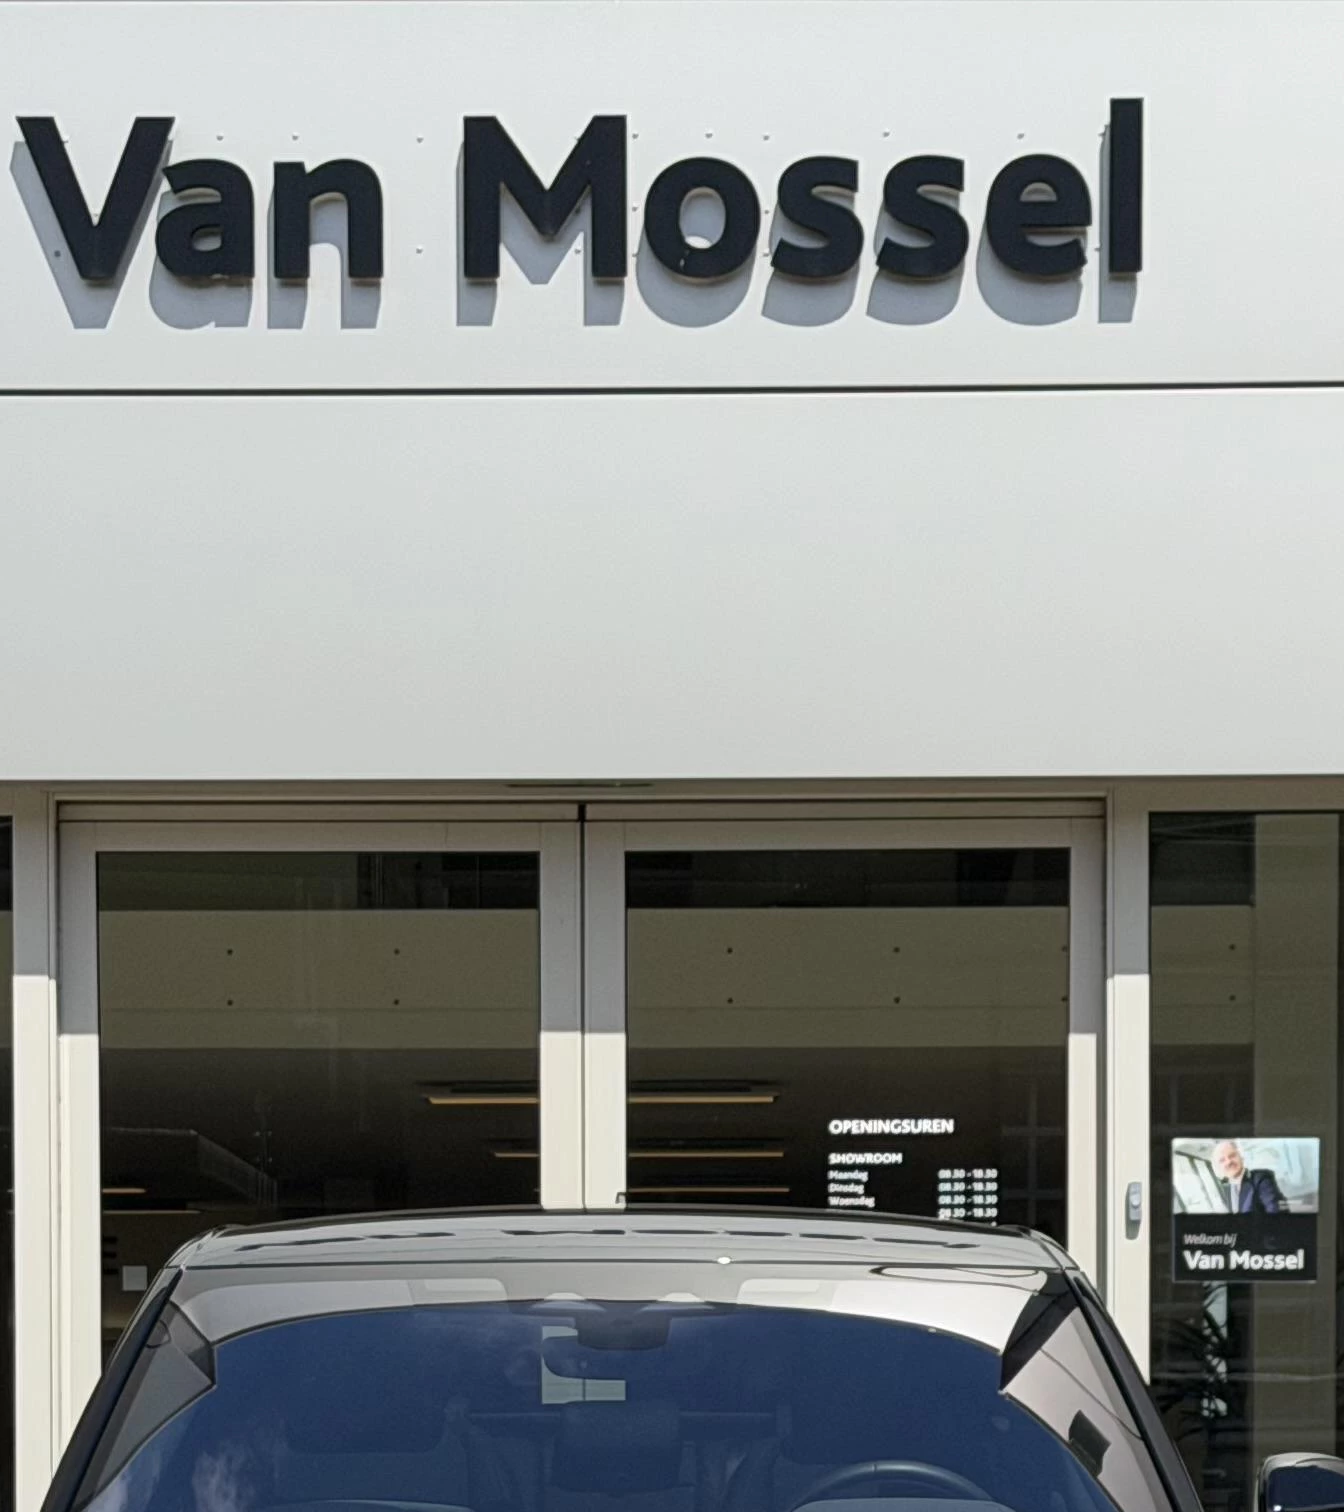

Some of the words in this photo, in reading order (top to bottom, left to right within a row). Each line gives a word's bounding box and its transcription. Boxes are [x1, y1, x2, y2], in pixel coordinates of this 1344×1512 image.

[15, 115, 383, 282] Van
[463, 97, 1143, 281] Mossel
[828, 1118, 954, 1135] OPENINGSUREN
[828, 1152, 903, 1165] SHOWROOM
[1183, 1233, 1222, 1245] Welkom
[1223, 1233, 1237, 1248] bij
[1183, 1250, 1225, 1270] Van
[1229, 1248, 1305, 1270] Mossel
